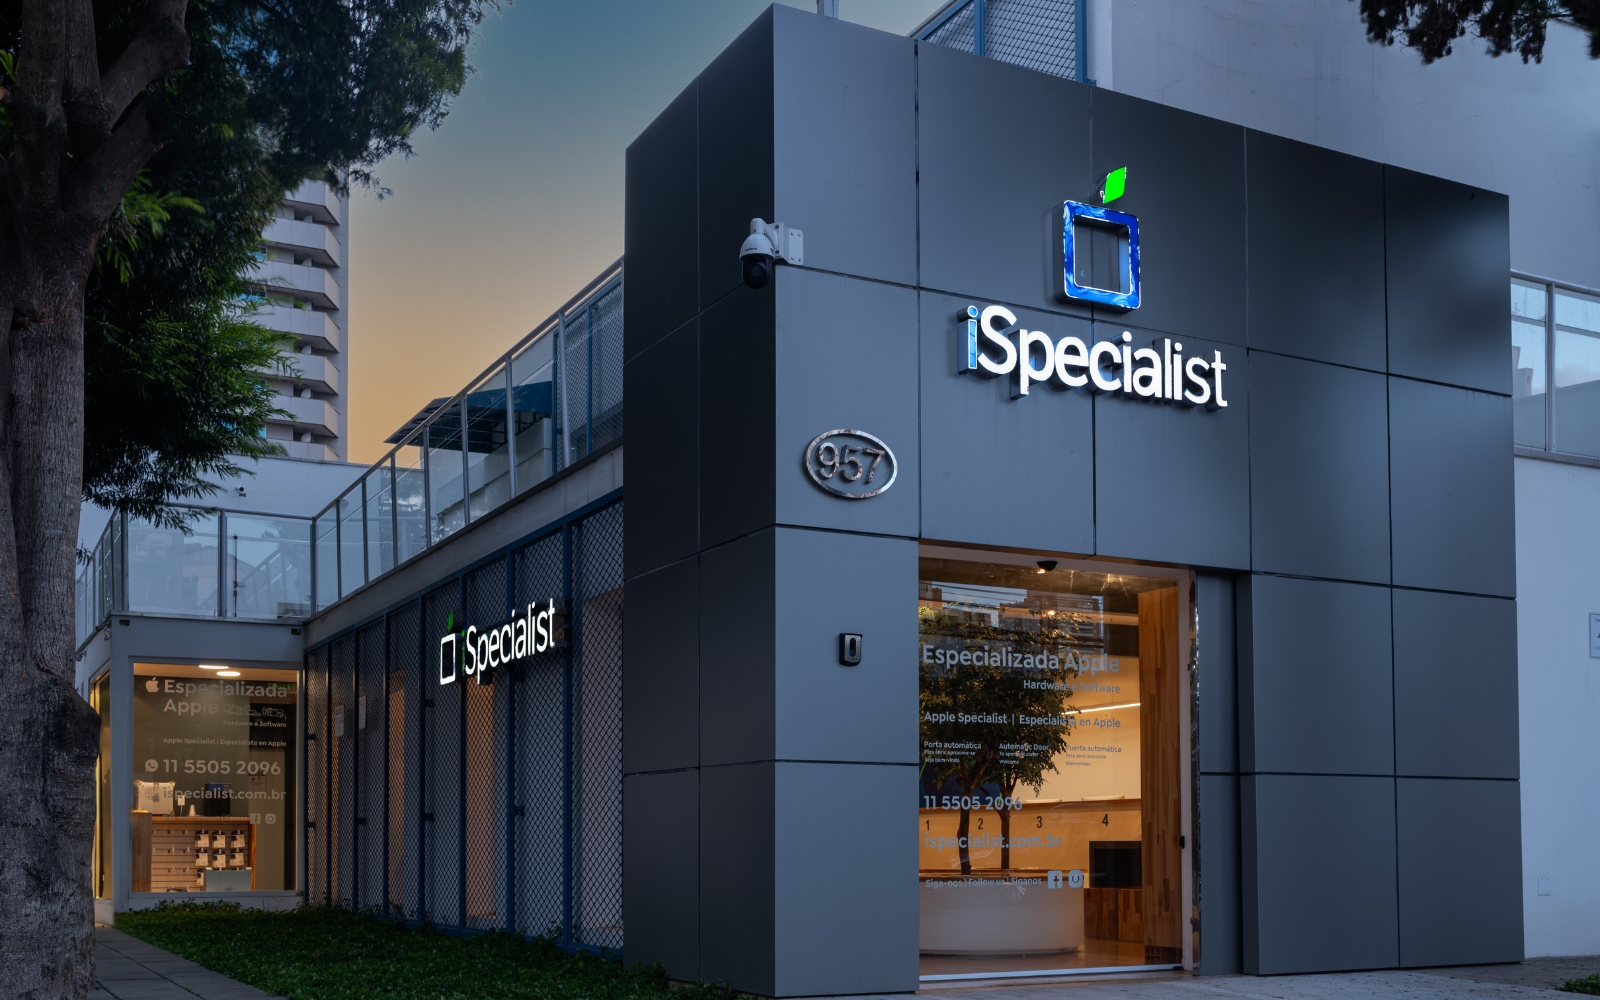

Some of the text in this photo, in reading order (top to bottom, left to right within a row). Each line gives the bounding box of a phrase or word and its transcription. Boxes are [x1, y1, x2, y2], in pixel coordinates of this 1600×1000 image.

[964, 304, 1228, 407] iSpecialist
[816, 442, 886, 484] 957
[461, 597, 555, 685] iSpecialist
[922, 644, 1120, 675] Especializada Apple
[164, 679, 288, 698] Especializada
[1023, 680, 1069, 691] Hardware
[1079, 683, 1121, 693] Software
[163, 698, 219, 716] Apple
[259, 720, 287, 728] Software
[924, 711, 956, 724] Apple
[957, 712, 1008, 726] Specialist
[1019, 714, 1077, 728] Especialista
[1093, 717, 1121, 729] Apple
[163, 737, 183, 745] Apple
[184, 738, 216, 746] Specialist
[220, 739, 258, 747] Especialista
[923, 741, 942, 749] Porta
[162, 759, 281, 776] 11 5505 2096
[163, 786, 287, 801] ispecialist.com.br
[923, 795, 1023, 811] 11 5505 2096
[925, 819, 930, 831] 1
[978, 818, 984, 830] 2
[1036, 816, 1043, 829] 3
[1102, 814, 1109, 827] 4
[924, 832, 1063, 851] ispecialist.com.br
[925, 878, 963, 889] Siga-nos
[968, 877, 995, 887] Follow
[1010, 877, 1042, 887] Siganos
